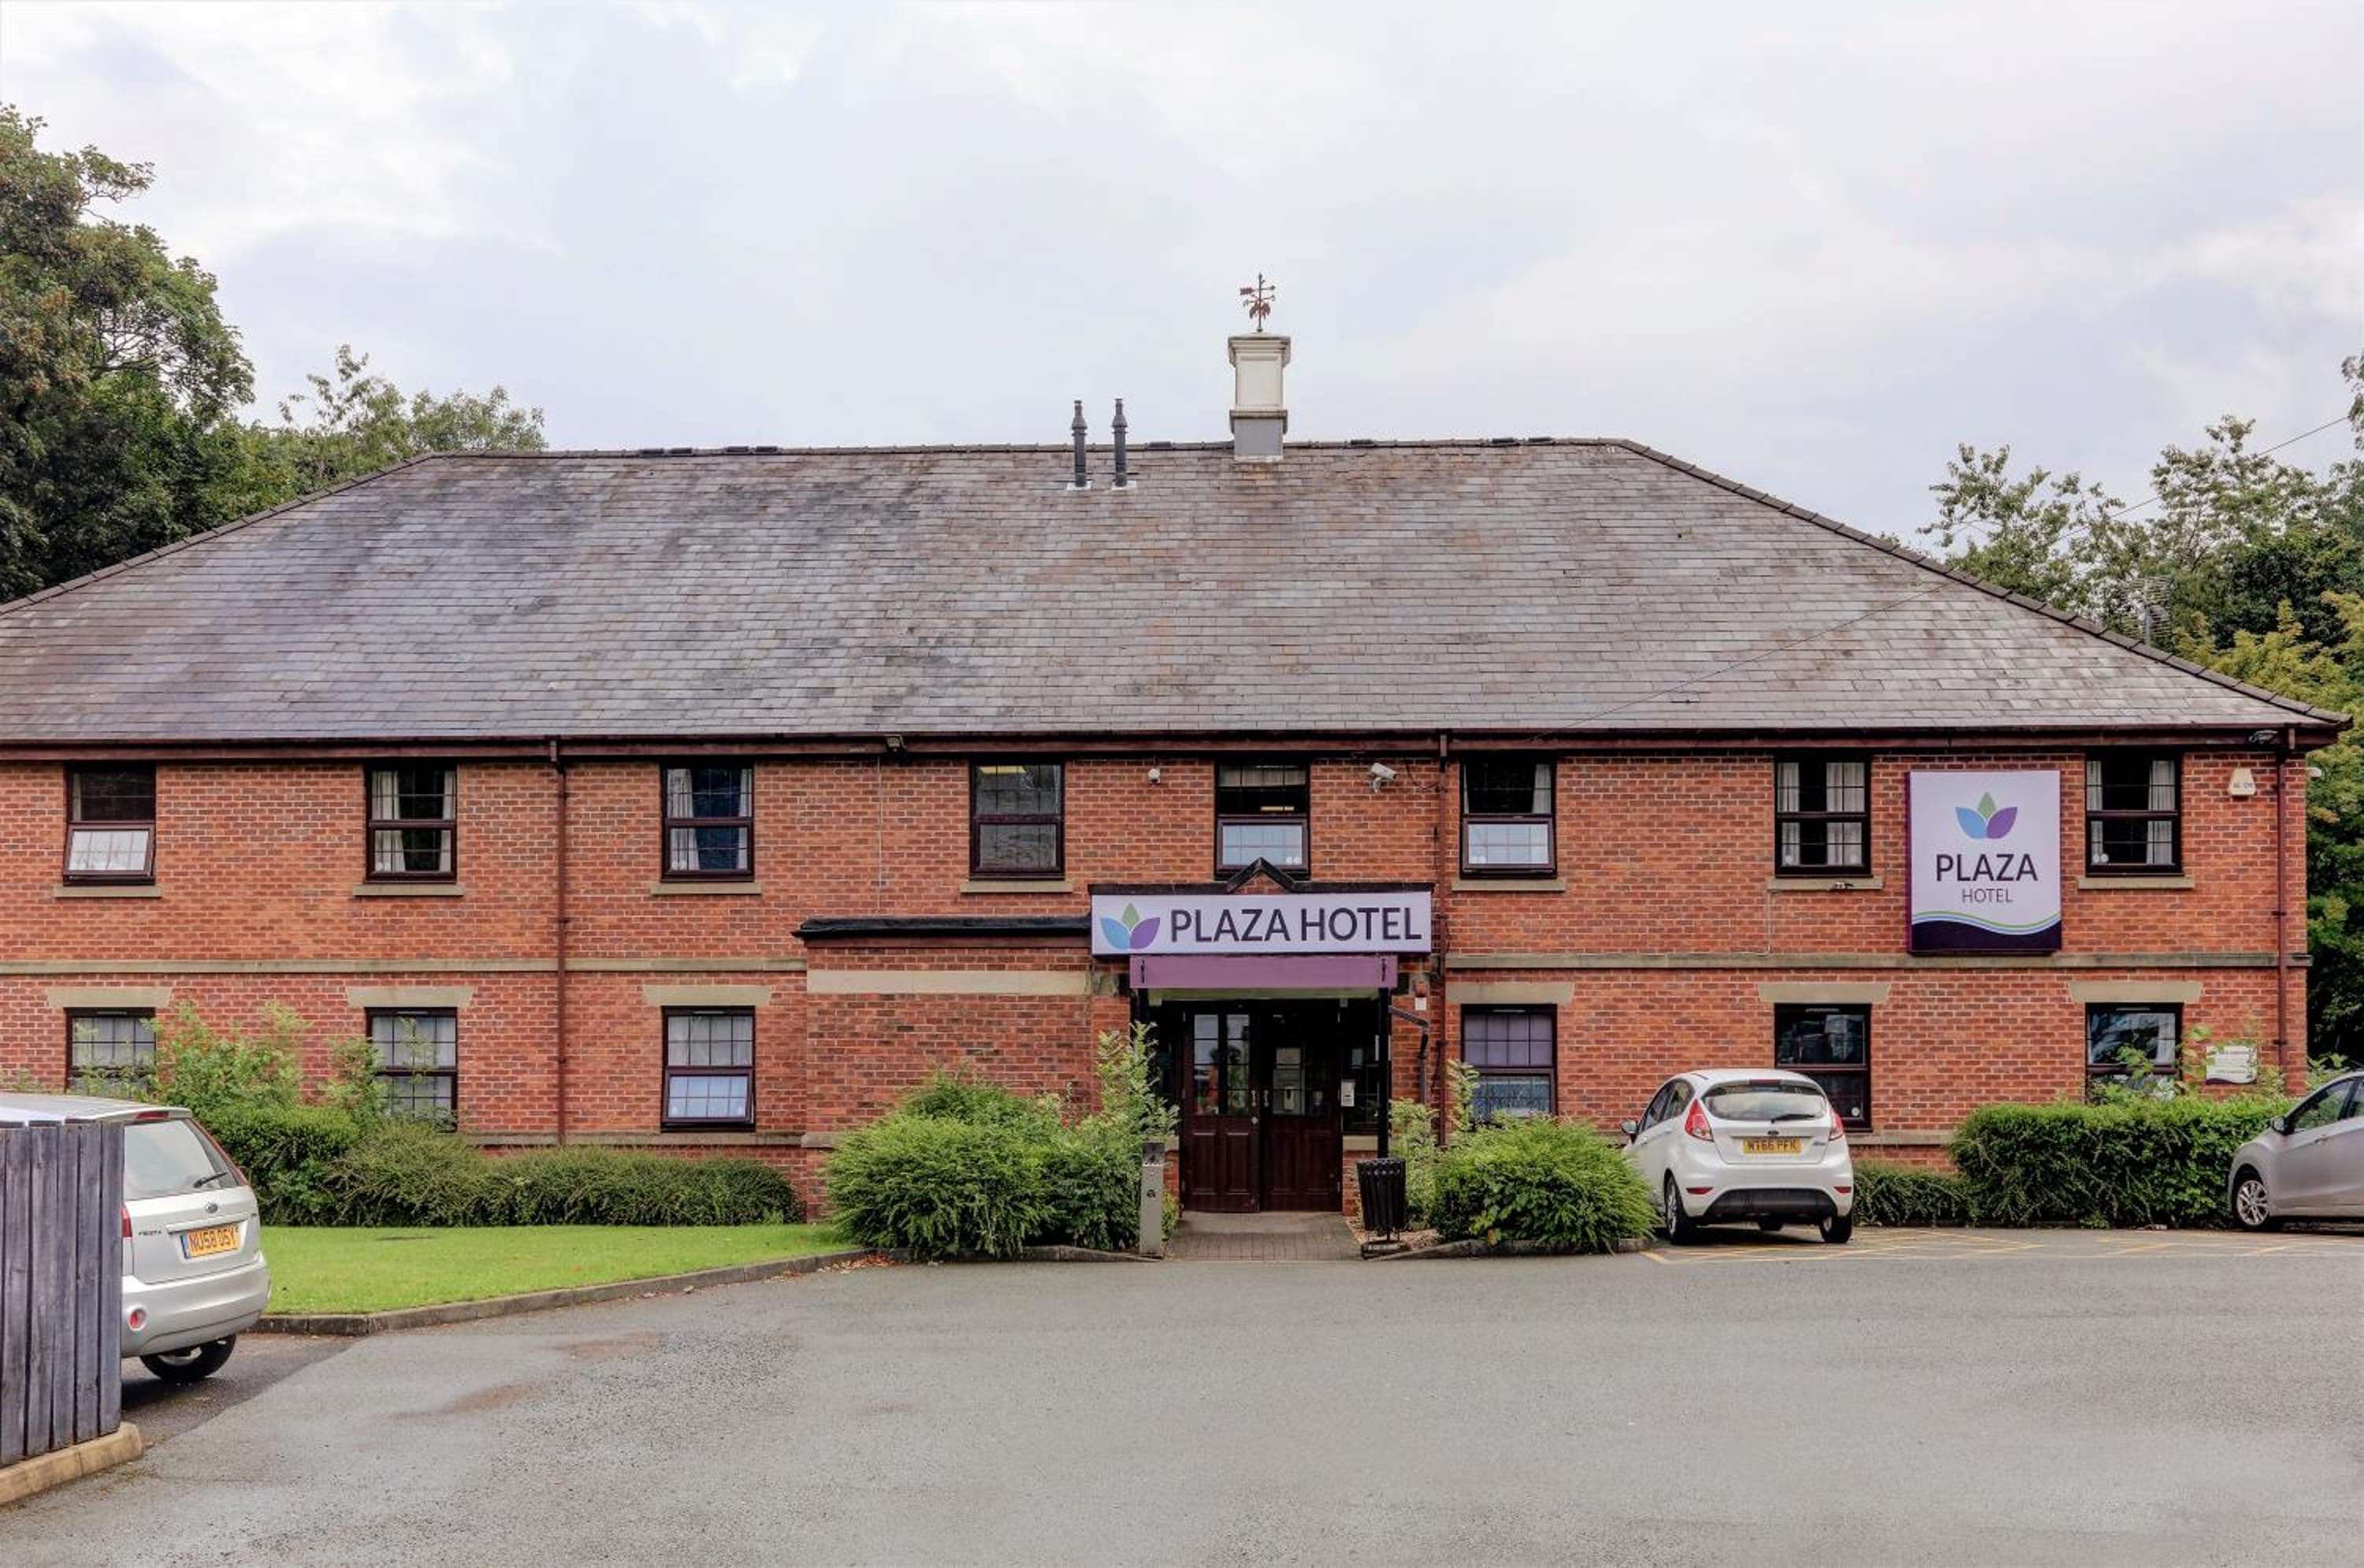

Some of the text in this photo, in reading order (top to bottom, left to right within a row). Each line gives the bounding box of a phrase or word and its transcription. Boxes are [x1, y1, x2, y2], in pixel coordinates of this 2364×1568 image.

[1936, 853, 2039, 882] PLAZA
[1962, 888, 2014, 903] HOTEL
[1170, 907, 1422, 942] PLAZA HOTEL
